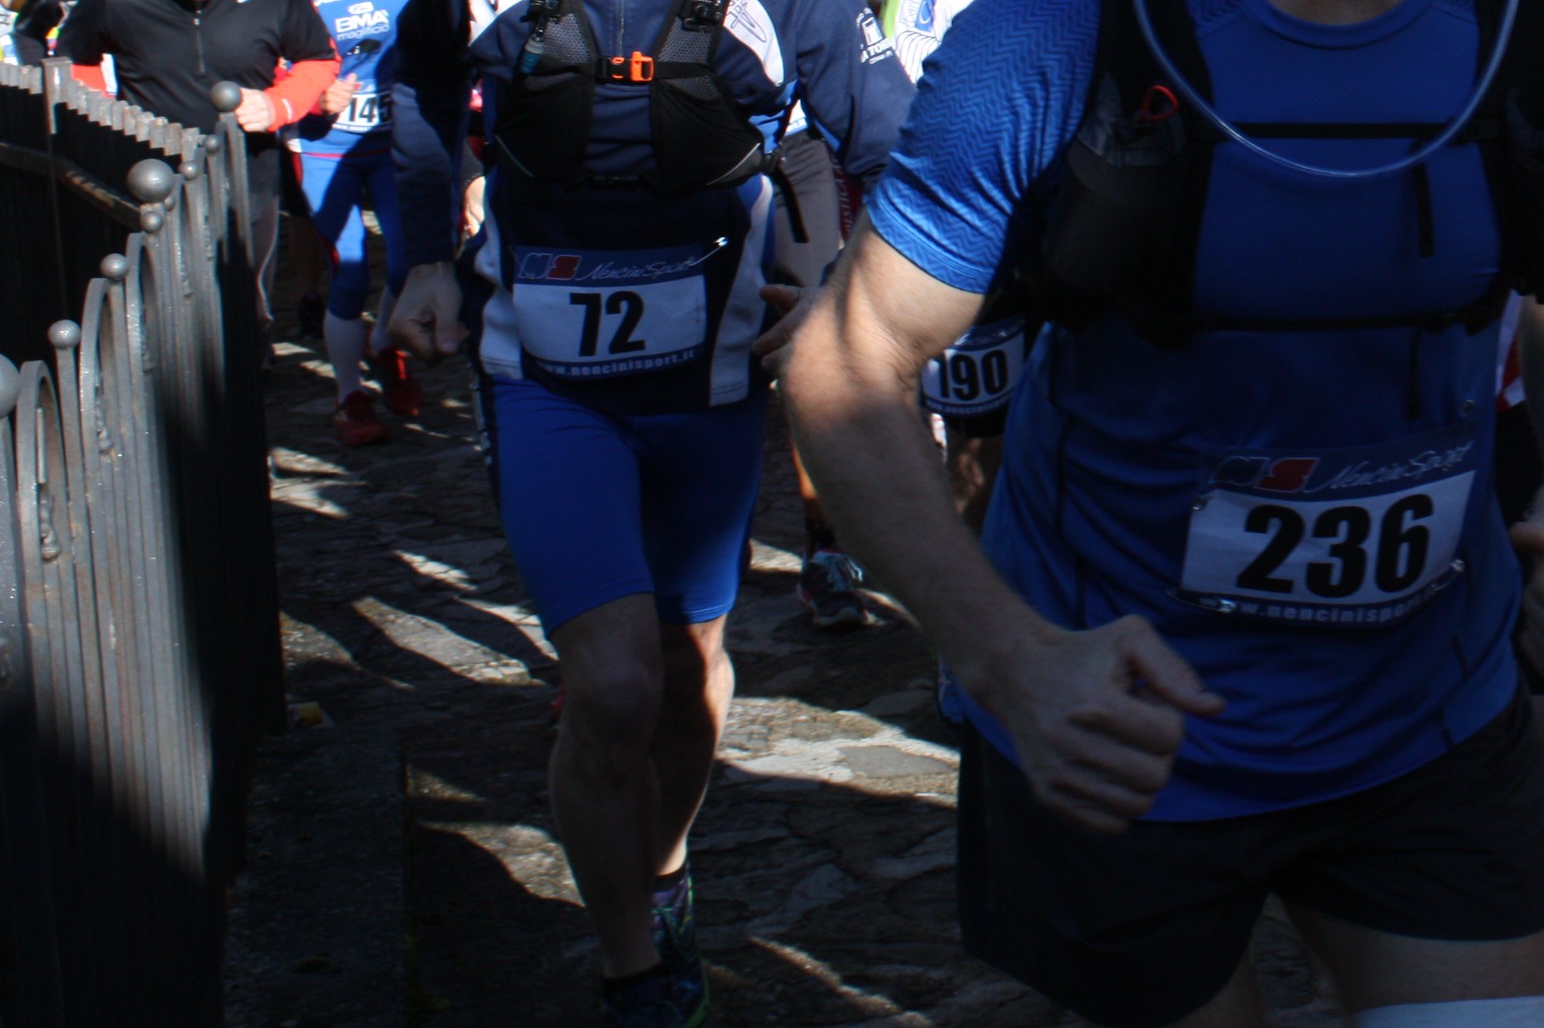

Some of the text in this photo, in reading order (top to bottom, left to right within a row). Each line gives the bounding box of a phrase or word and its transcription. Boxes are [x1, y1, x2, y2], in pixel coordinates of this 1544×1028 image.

[569, 290, 645, 356] 72
[938, 349, 1008, 401] 190
[1237, 493, 1434, 598] 236
